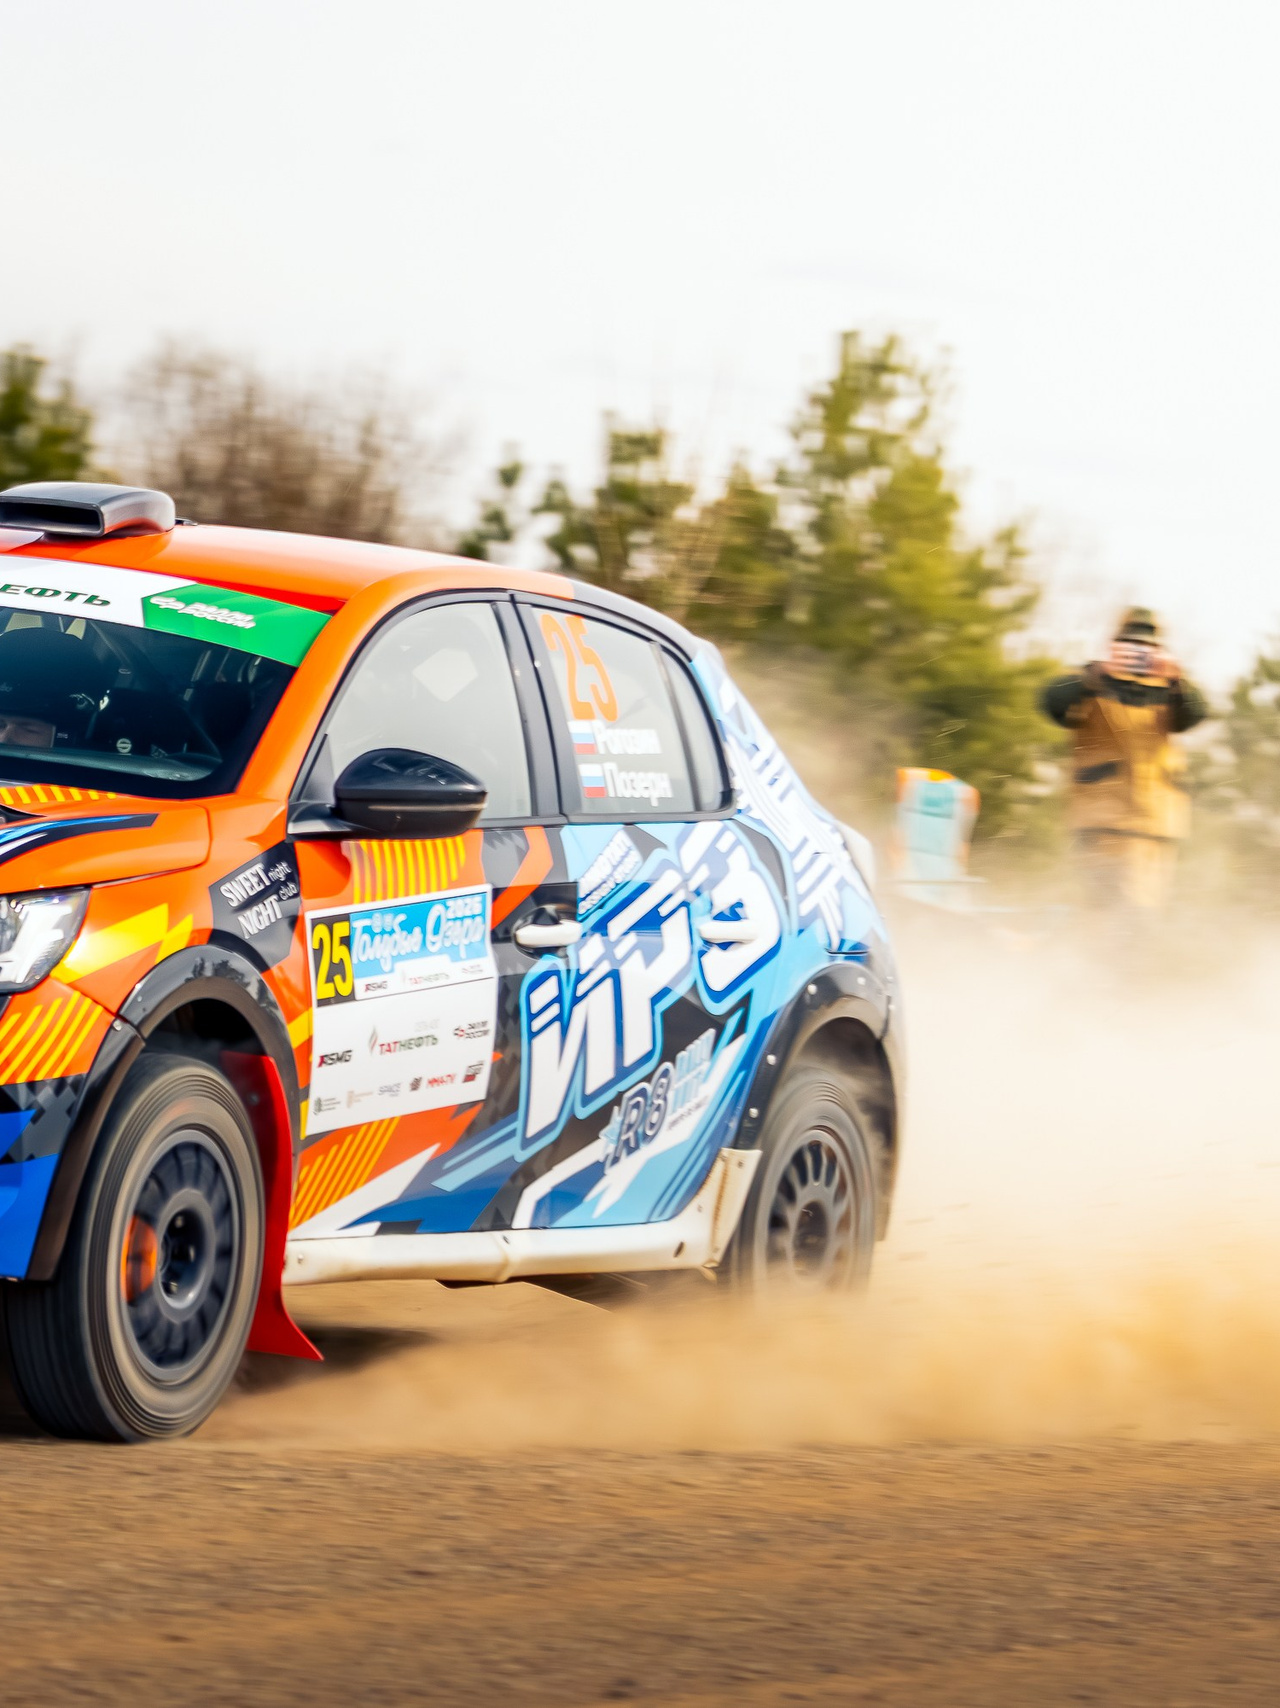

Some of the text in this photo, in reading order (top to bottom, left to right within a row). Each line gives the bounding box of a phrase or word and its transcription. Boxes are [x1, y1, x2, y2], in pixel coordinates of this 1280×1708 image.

[540, 614, 619, 722] 25
[220, 861, 293, 907] SWEET night
[237, 881, 298, 939] NIGHT club
[312, 921, 354, 1000] 25
[378, 1034, 439, 1056] ТАТНЕФТЬ
